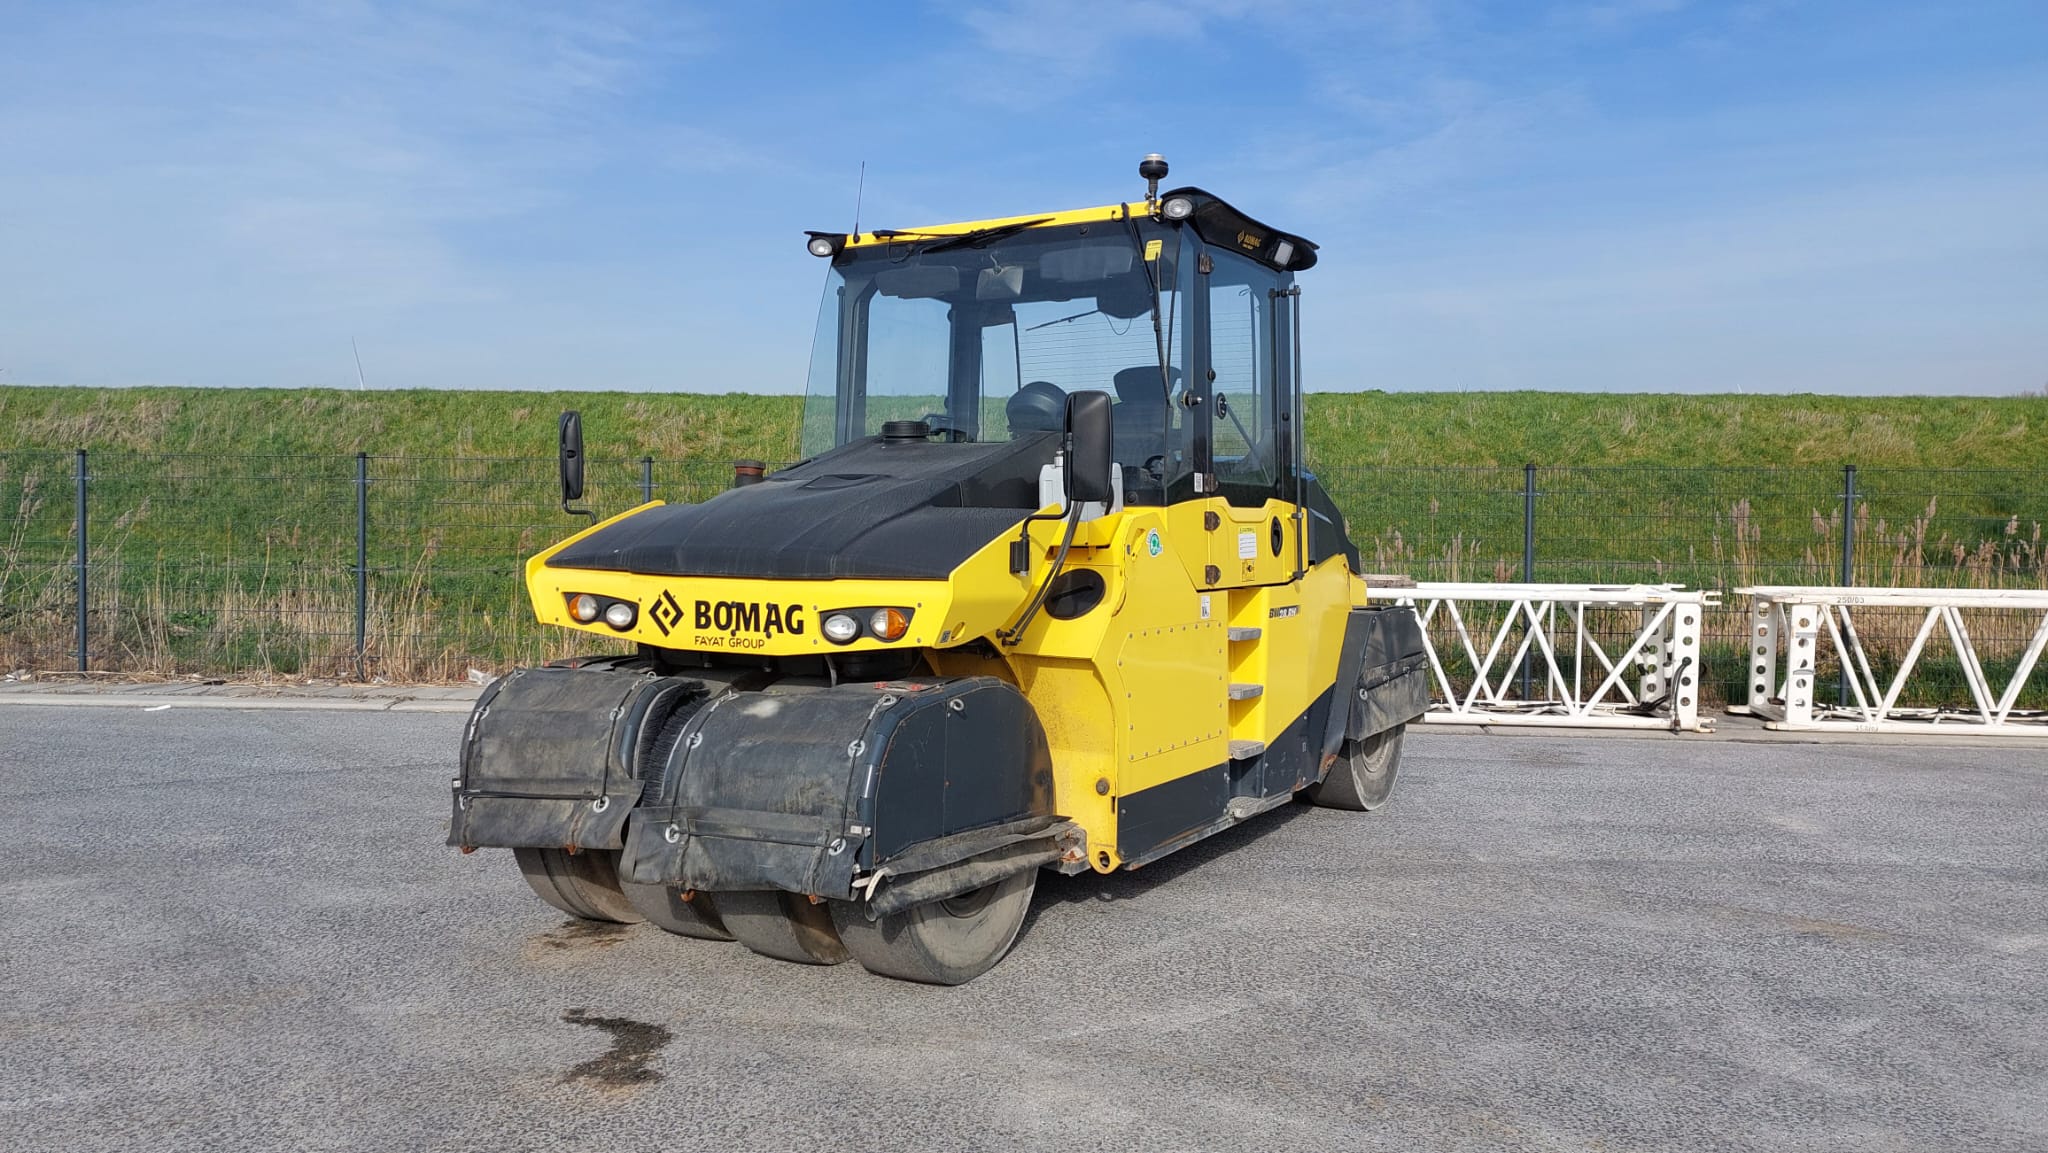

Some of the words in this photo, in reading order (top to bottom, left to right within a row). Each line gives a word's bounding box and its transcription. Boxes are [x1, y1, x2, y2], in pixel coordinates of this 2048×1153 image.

[695, 600, 804, 635] BOMAG
[694, 636, 725, 647] FAYAT
[728, 638, 765, 649] GROUP
